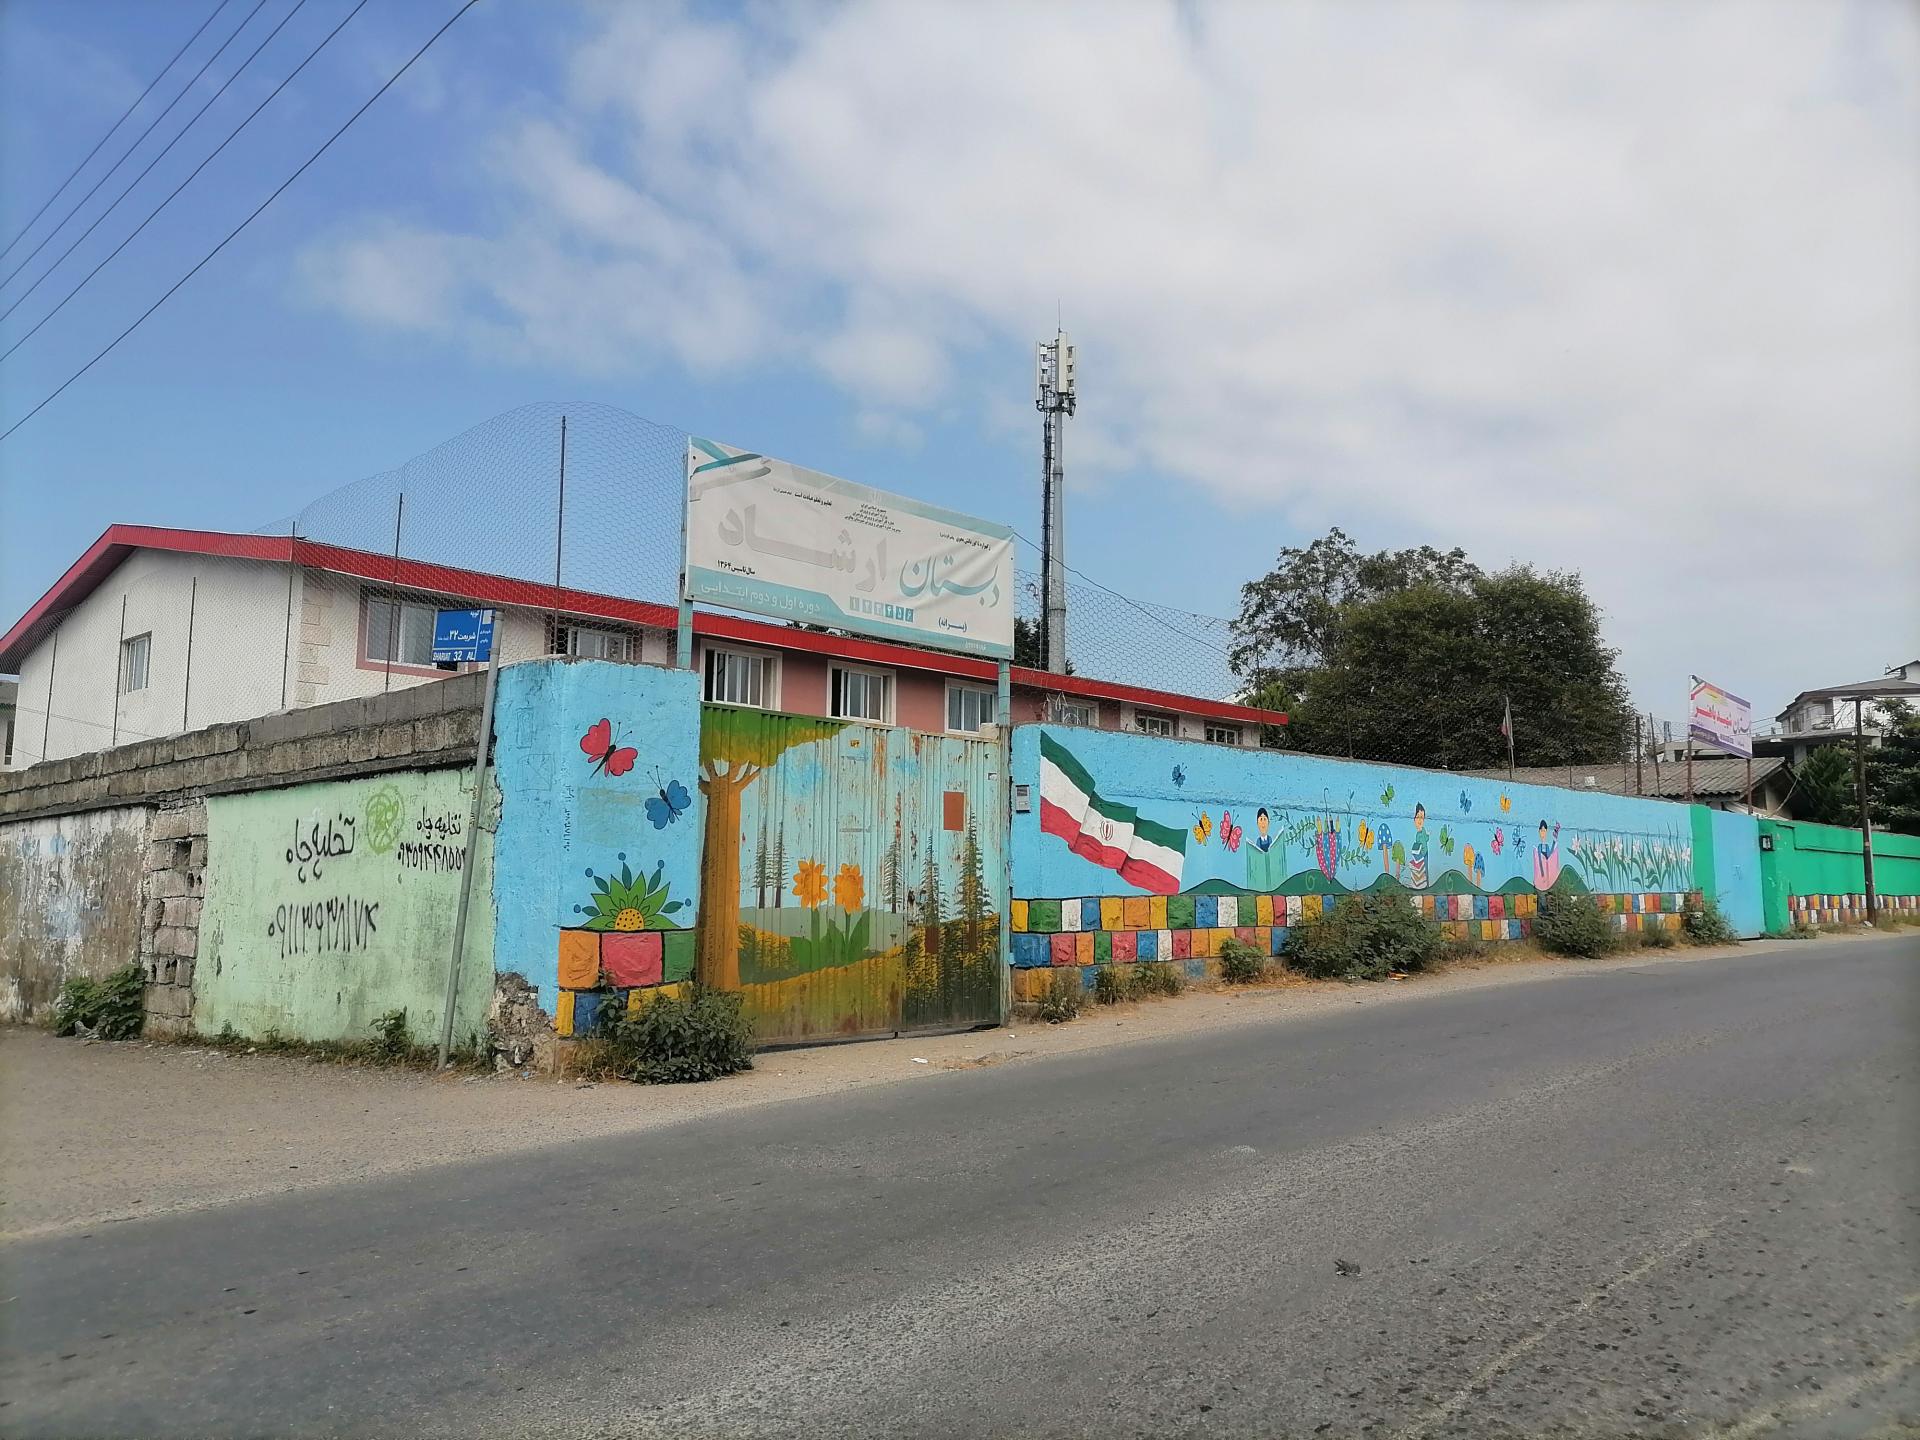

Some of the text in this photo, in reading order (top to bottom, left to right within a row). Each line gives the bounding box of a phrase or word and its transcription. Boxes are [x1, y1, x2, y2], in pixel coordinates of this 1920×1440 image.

[718, 503, 1000, 608] دبستان ارشاد
[701, 580, 821, 614] دوره اول و دوم ابتدایی
[453, 650, 463, 661] 32
[416, 805, 462, 840] تخلیه چاه
[286, 812, 356, 883] تخلیه چاه
